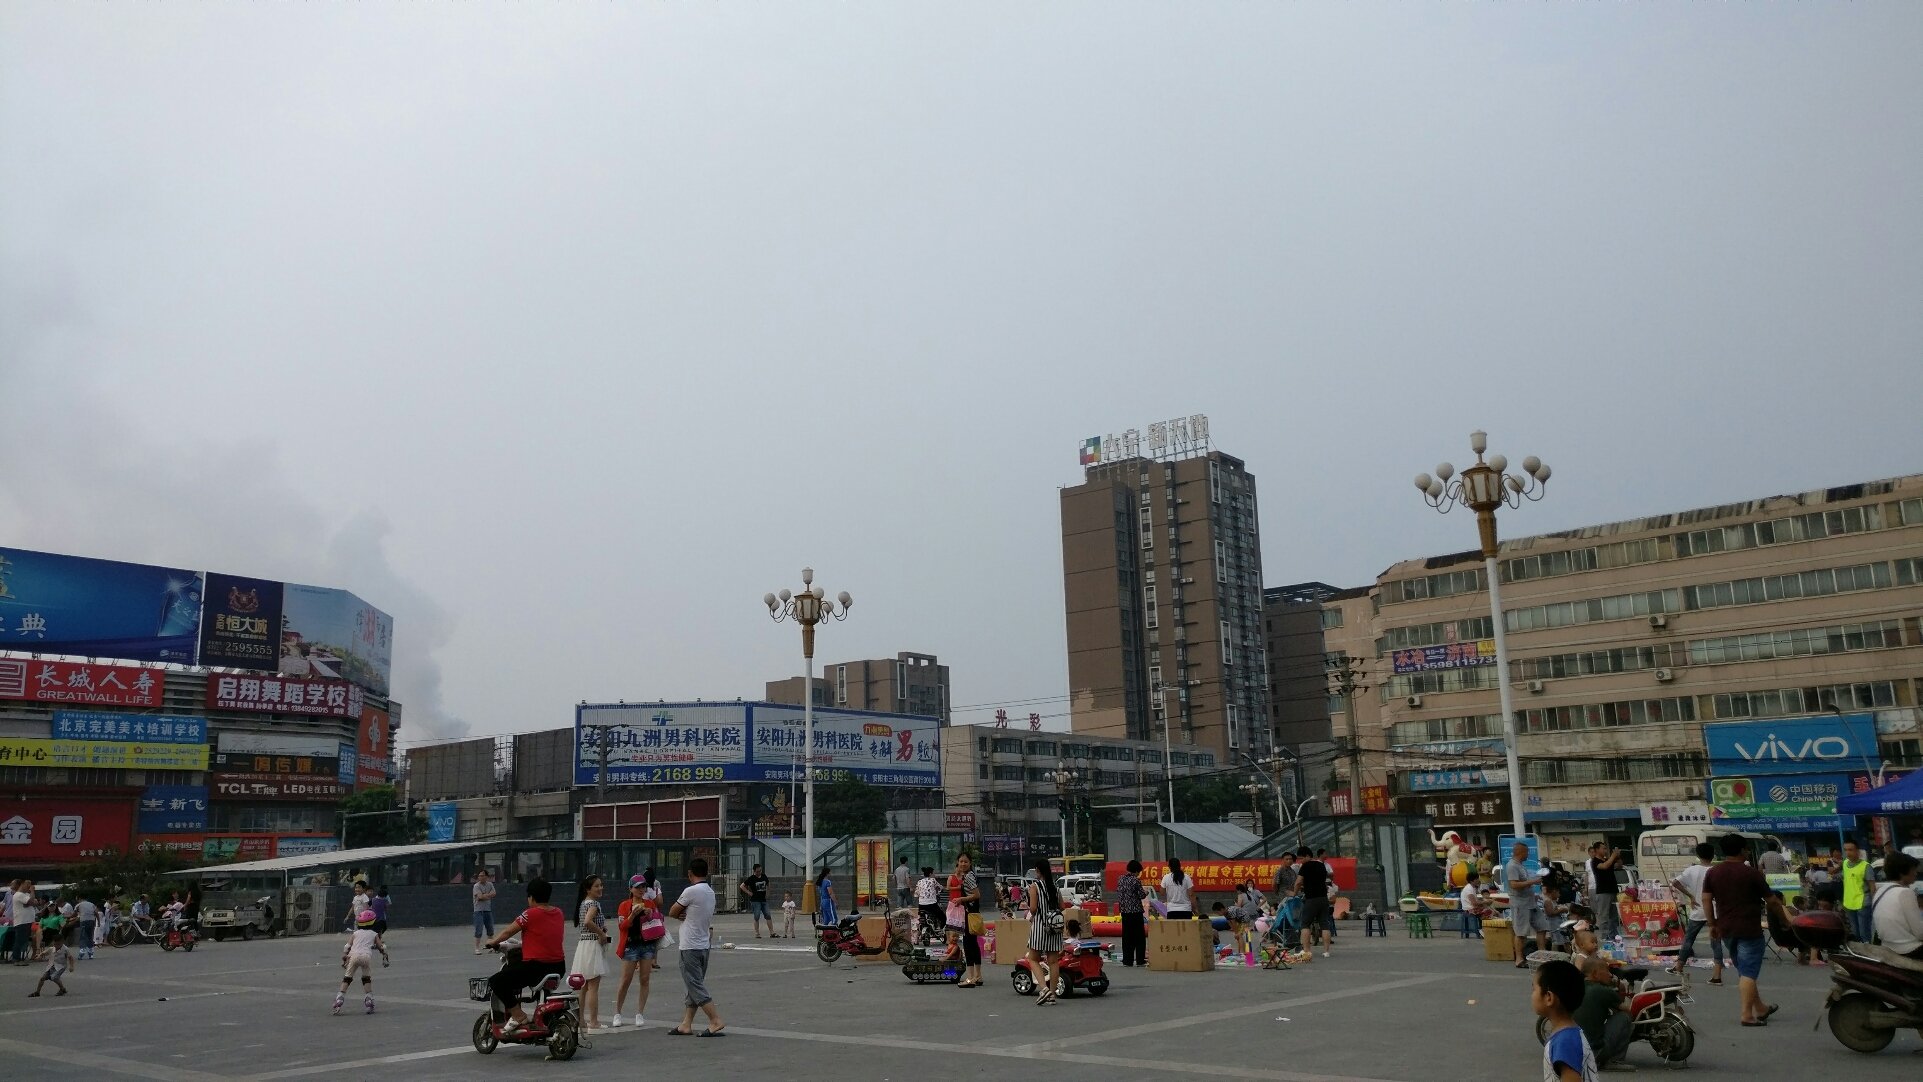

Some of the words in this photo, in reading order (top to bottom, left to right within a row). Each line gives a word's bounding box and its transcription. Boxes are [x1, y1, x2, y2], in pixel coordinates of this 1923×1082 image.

[226, 615, 268, 635] 恒大城
[225, 641, 273, 656] 2595555
[35, 664, 155, 696] 长城人寿
[37, 690, 122, 703] GREATWALL
[125, 694, 153, 705] LIFE
[217, 677, 347, 707] 启翔舞蹈学校
[59, 719, 200, 738] 北京完美美术培训学校
[996, 709, 1041, 732] 光彩
[584, 727, 741, 749] 安阳九洲男科医院
[1734, 733, 1850, 763] vivo
[652, 768, 692, 782] 2168
[695, 767, 724, 781] 999
[1790, 784, 1838, 795] 中国移动
[169, 798, 206, 811] 新飞
[1425, 801, 1495, 818] 新旺皮鞋
